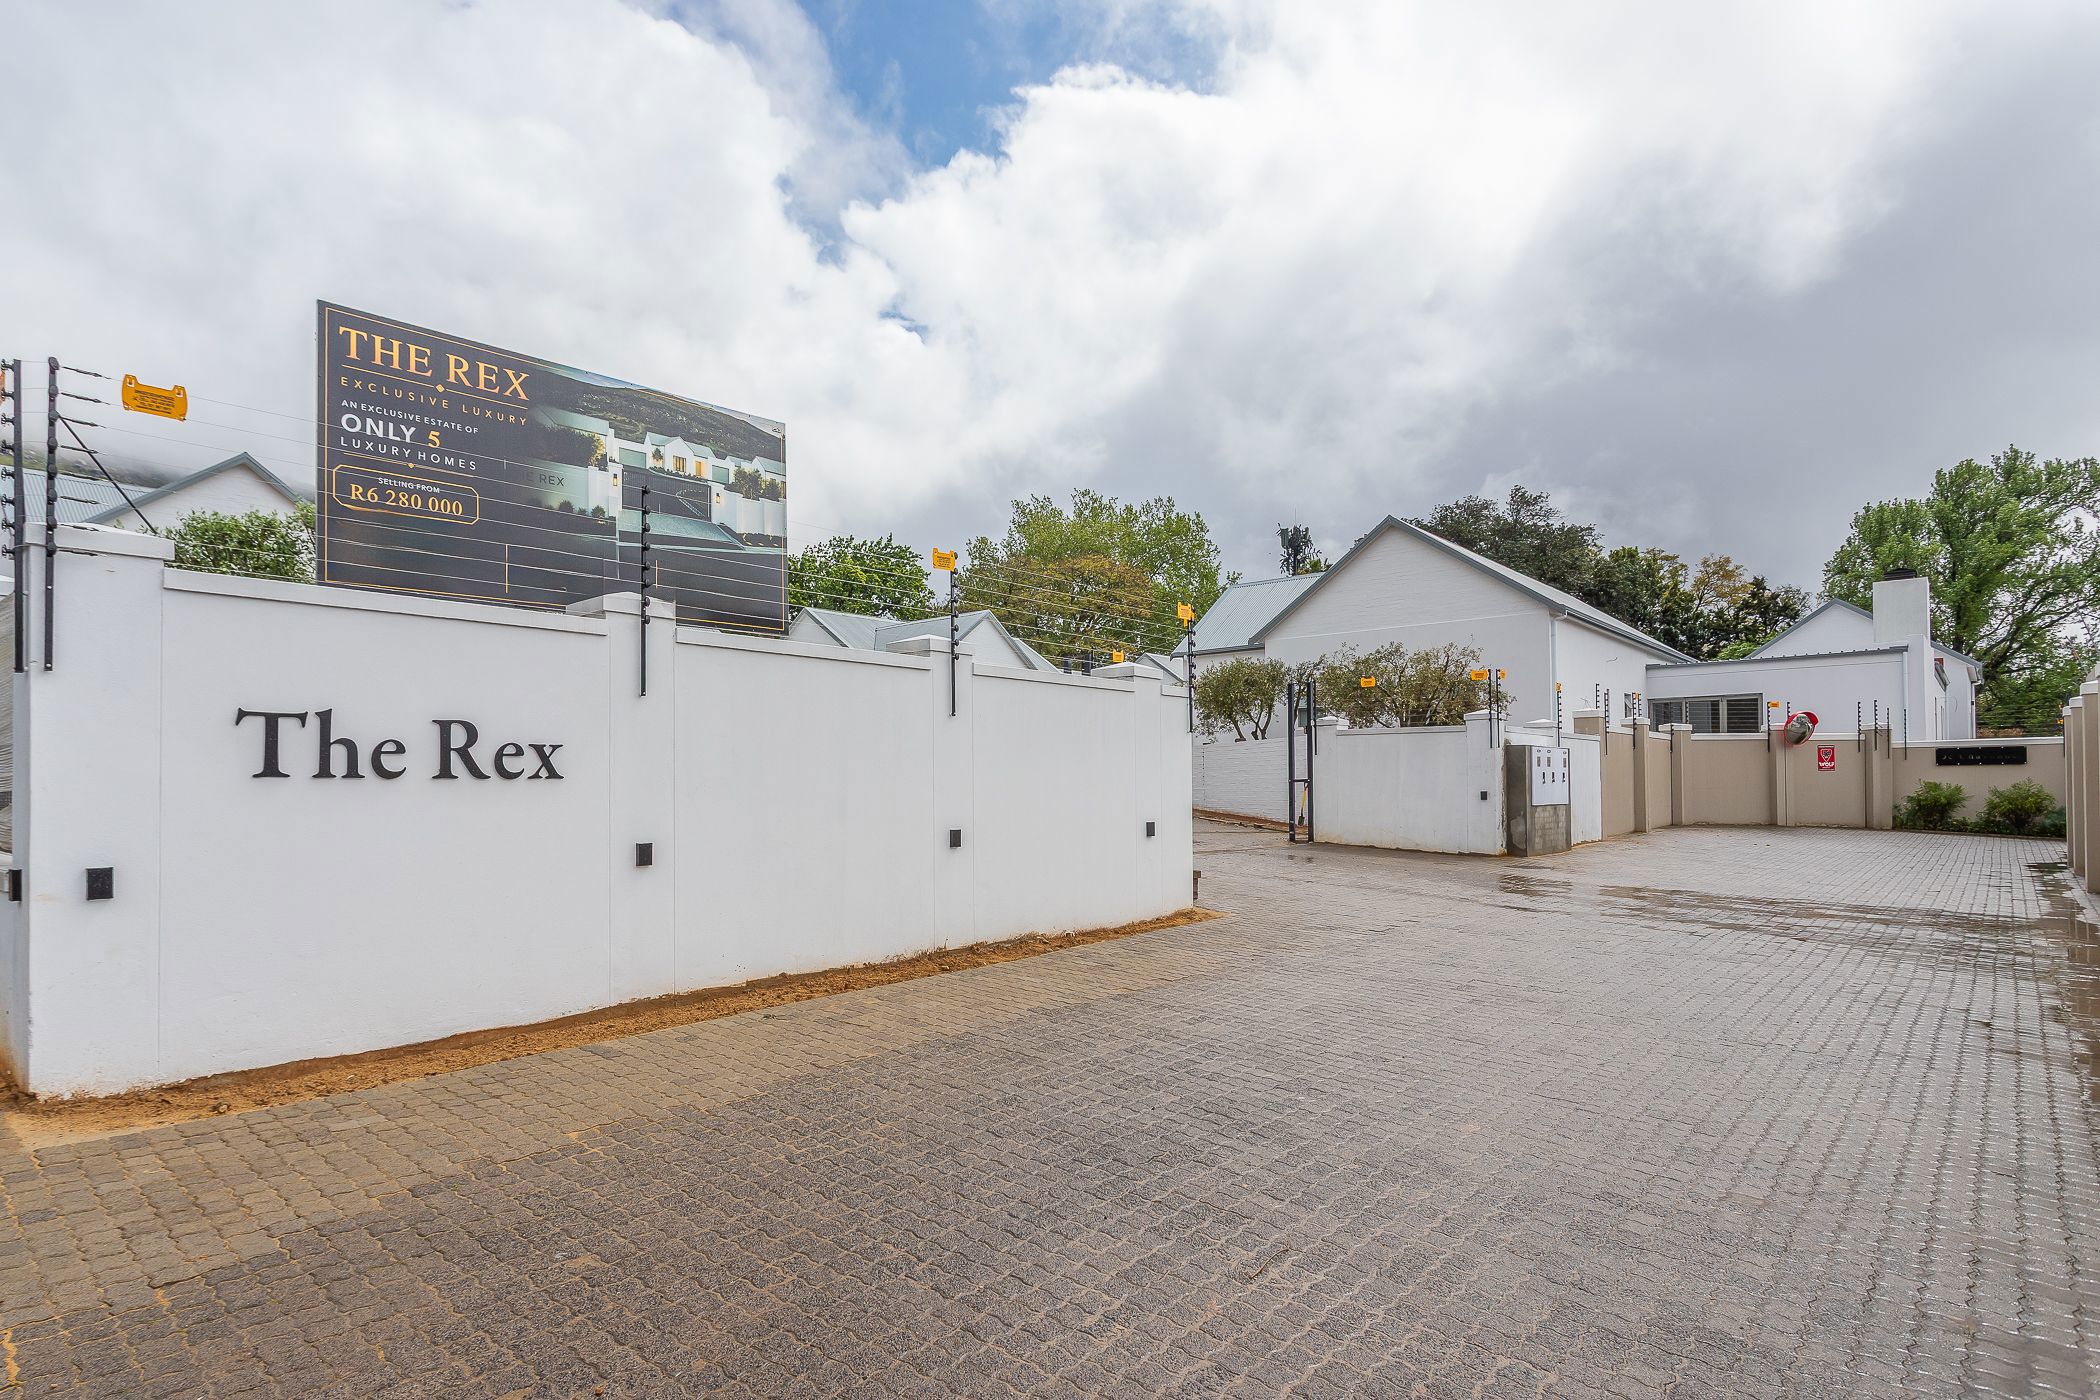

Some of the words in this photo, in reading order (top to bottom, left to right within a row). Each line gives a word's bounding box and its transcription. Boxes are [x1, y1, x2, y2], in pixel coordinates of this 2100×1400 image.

[338, 326, 433, 377] THE
[445, 353, 530, 401] REX
[340, 376, 449, 408] EXCLUSIVE
[462, 404, 527, 426] LUXURY
[341, 399, 358, 409] AN
[361, 403, 421, 423] EXCLUSIVE
[424, 416, 462, 431] ESTATE
[464, 425, 479, 434] OF
[341, 413, 416, 443] ONLY
[427, 430, 441, 448] 5
[340, 436, 411, 458] LUXURY
[418, 451, 476, 471] HOMES
[378, 477, 414, 490] SELLING
[416, 483, 440, 493] FROM
[539, 473, 565, 486] REX
[350, 483, 379, 503] R6
[385, 489, 422, 509] 280
[428, 496, 463, 516] 000
[235, 707, 407, 780] The
[431, 719, 565, 780] Rex
